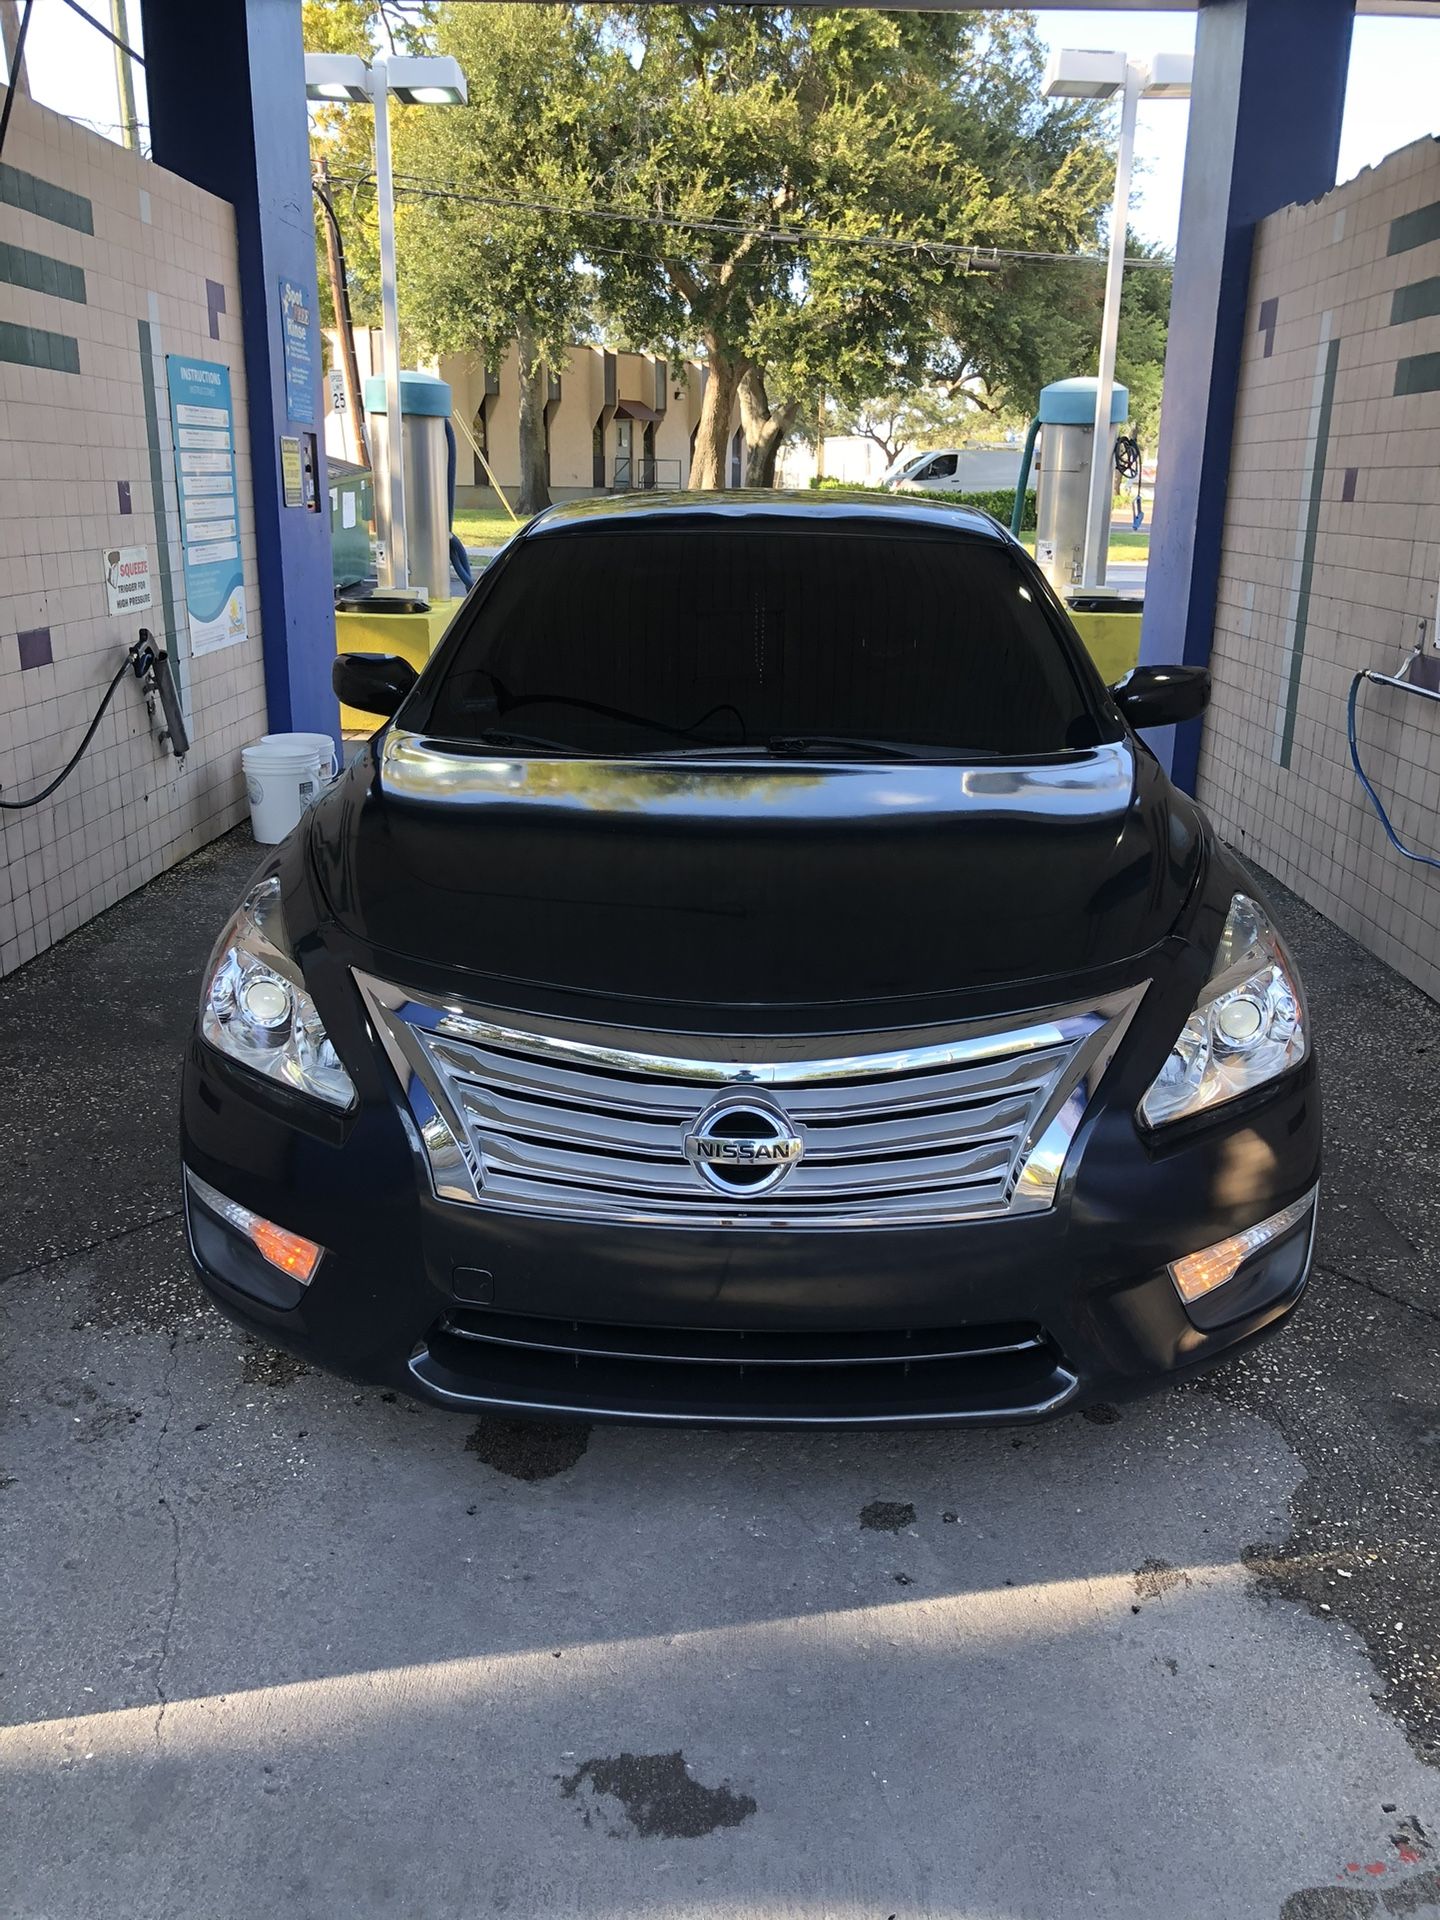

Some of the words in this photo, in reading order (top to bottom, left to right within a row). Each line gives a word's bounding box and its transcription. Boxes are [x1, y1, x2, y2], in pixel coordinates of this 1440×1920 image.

[285, 283, 303, 307] Spot
[287, 317, 306, 340] Rinse
[180, 366, 221, 386] INSTRUCTIONS
[333, 392, 346, 409] 25
[120, 560, 148, 578] SQUEEZE
[117, 582, 137, 594] TRIGGER
[116, 598, 129, 609] HIGH
[128, 593, 151, 607] PRESSURE
[697, 1142, 790, 1159] NISSAN
